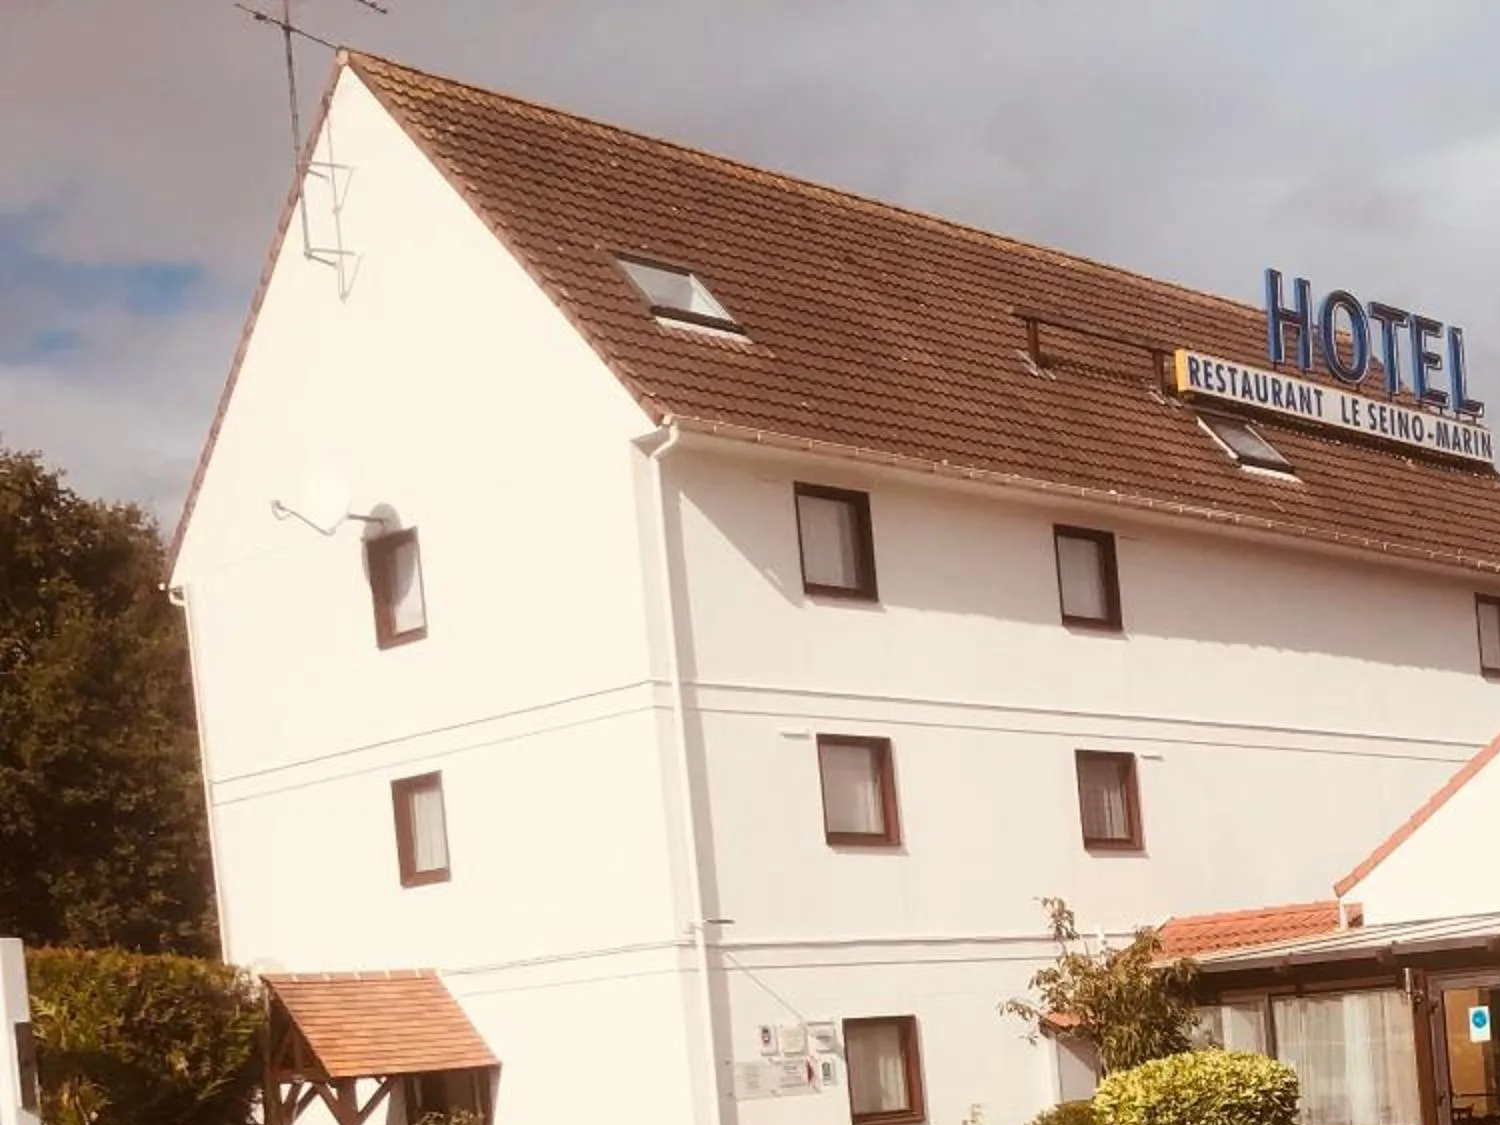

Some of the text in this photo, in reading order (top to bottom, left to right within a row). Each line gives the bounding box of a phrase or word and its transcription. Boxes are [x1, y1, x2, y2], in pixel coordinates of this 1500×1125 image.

[1264, 267, 1486, 419] HOTEL
[1187, 355, 1494, 460] RESTAURANT LE SEINO-MARIN
